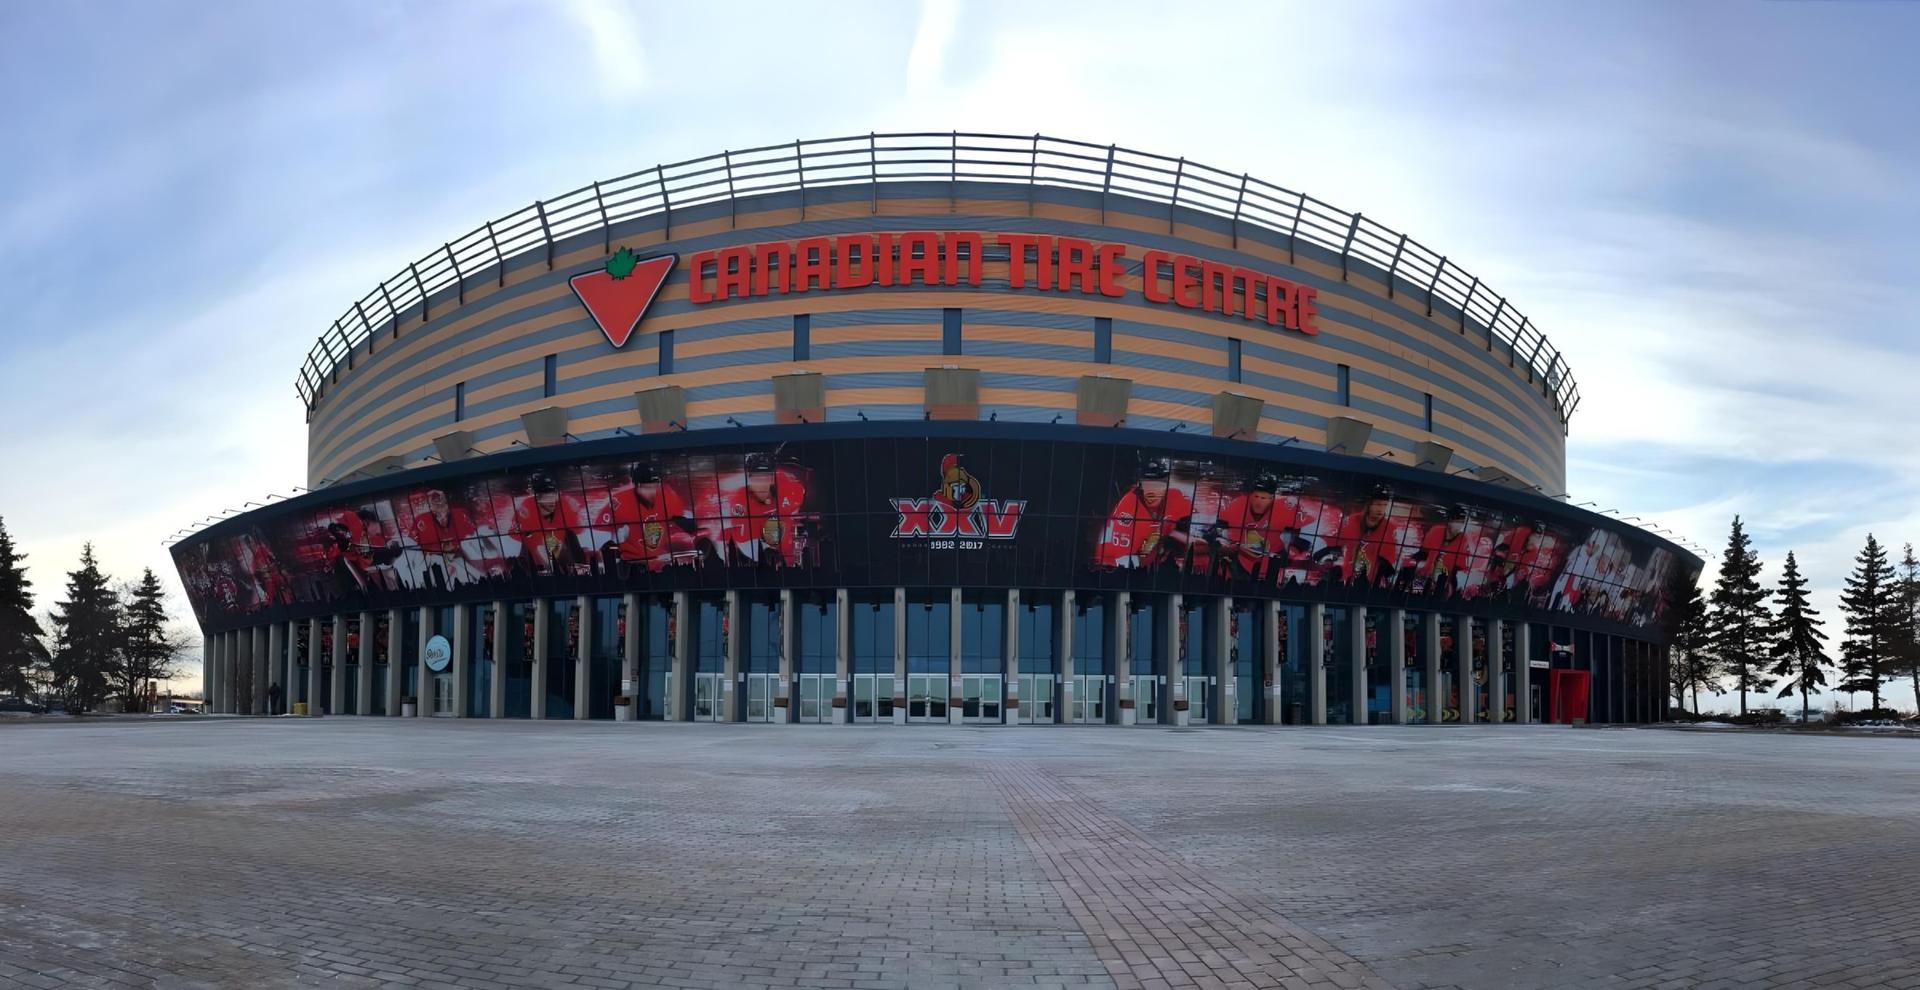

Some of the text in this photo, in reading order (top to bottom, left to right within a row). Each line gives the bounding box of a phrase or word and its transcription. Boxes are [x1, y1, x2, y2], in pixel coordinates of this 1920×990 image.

[689, 231, 1320, 335] CANADIAN TIRE CENTRE
[889, 498, 1028, 540] XXV
[930, 540, 955, 550] 1992
[959, 541, 983, 550] 2017
